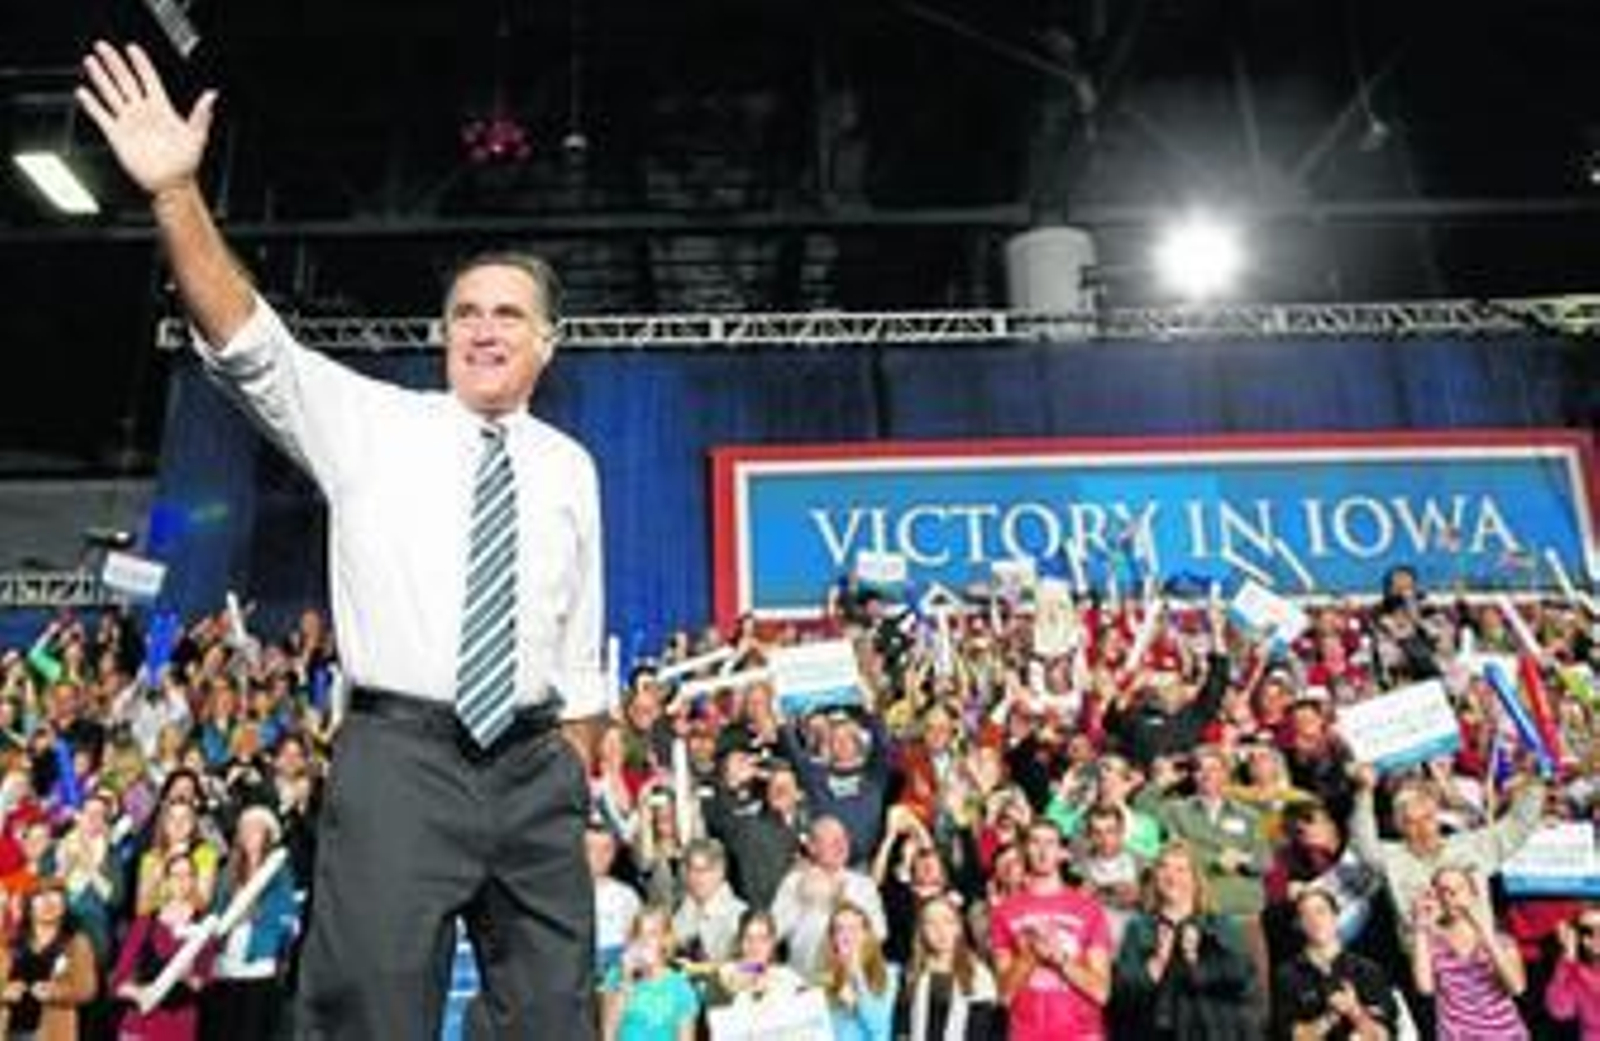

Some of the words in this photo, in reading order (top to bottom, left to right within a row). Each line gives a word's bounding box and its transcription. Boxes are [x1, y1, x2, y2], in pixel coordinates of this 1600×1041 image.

[809, 502, 1156, 567] VICTORY
[1188, 498, 1271, 558] IN
[1304, 495, 1518, 557] IOWA
